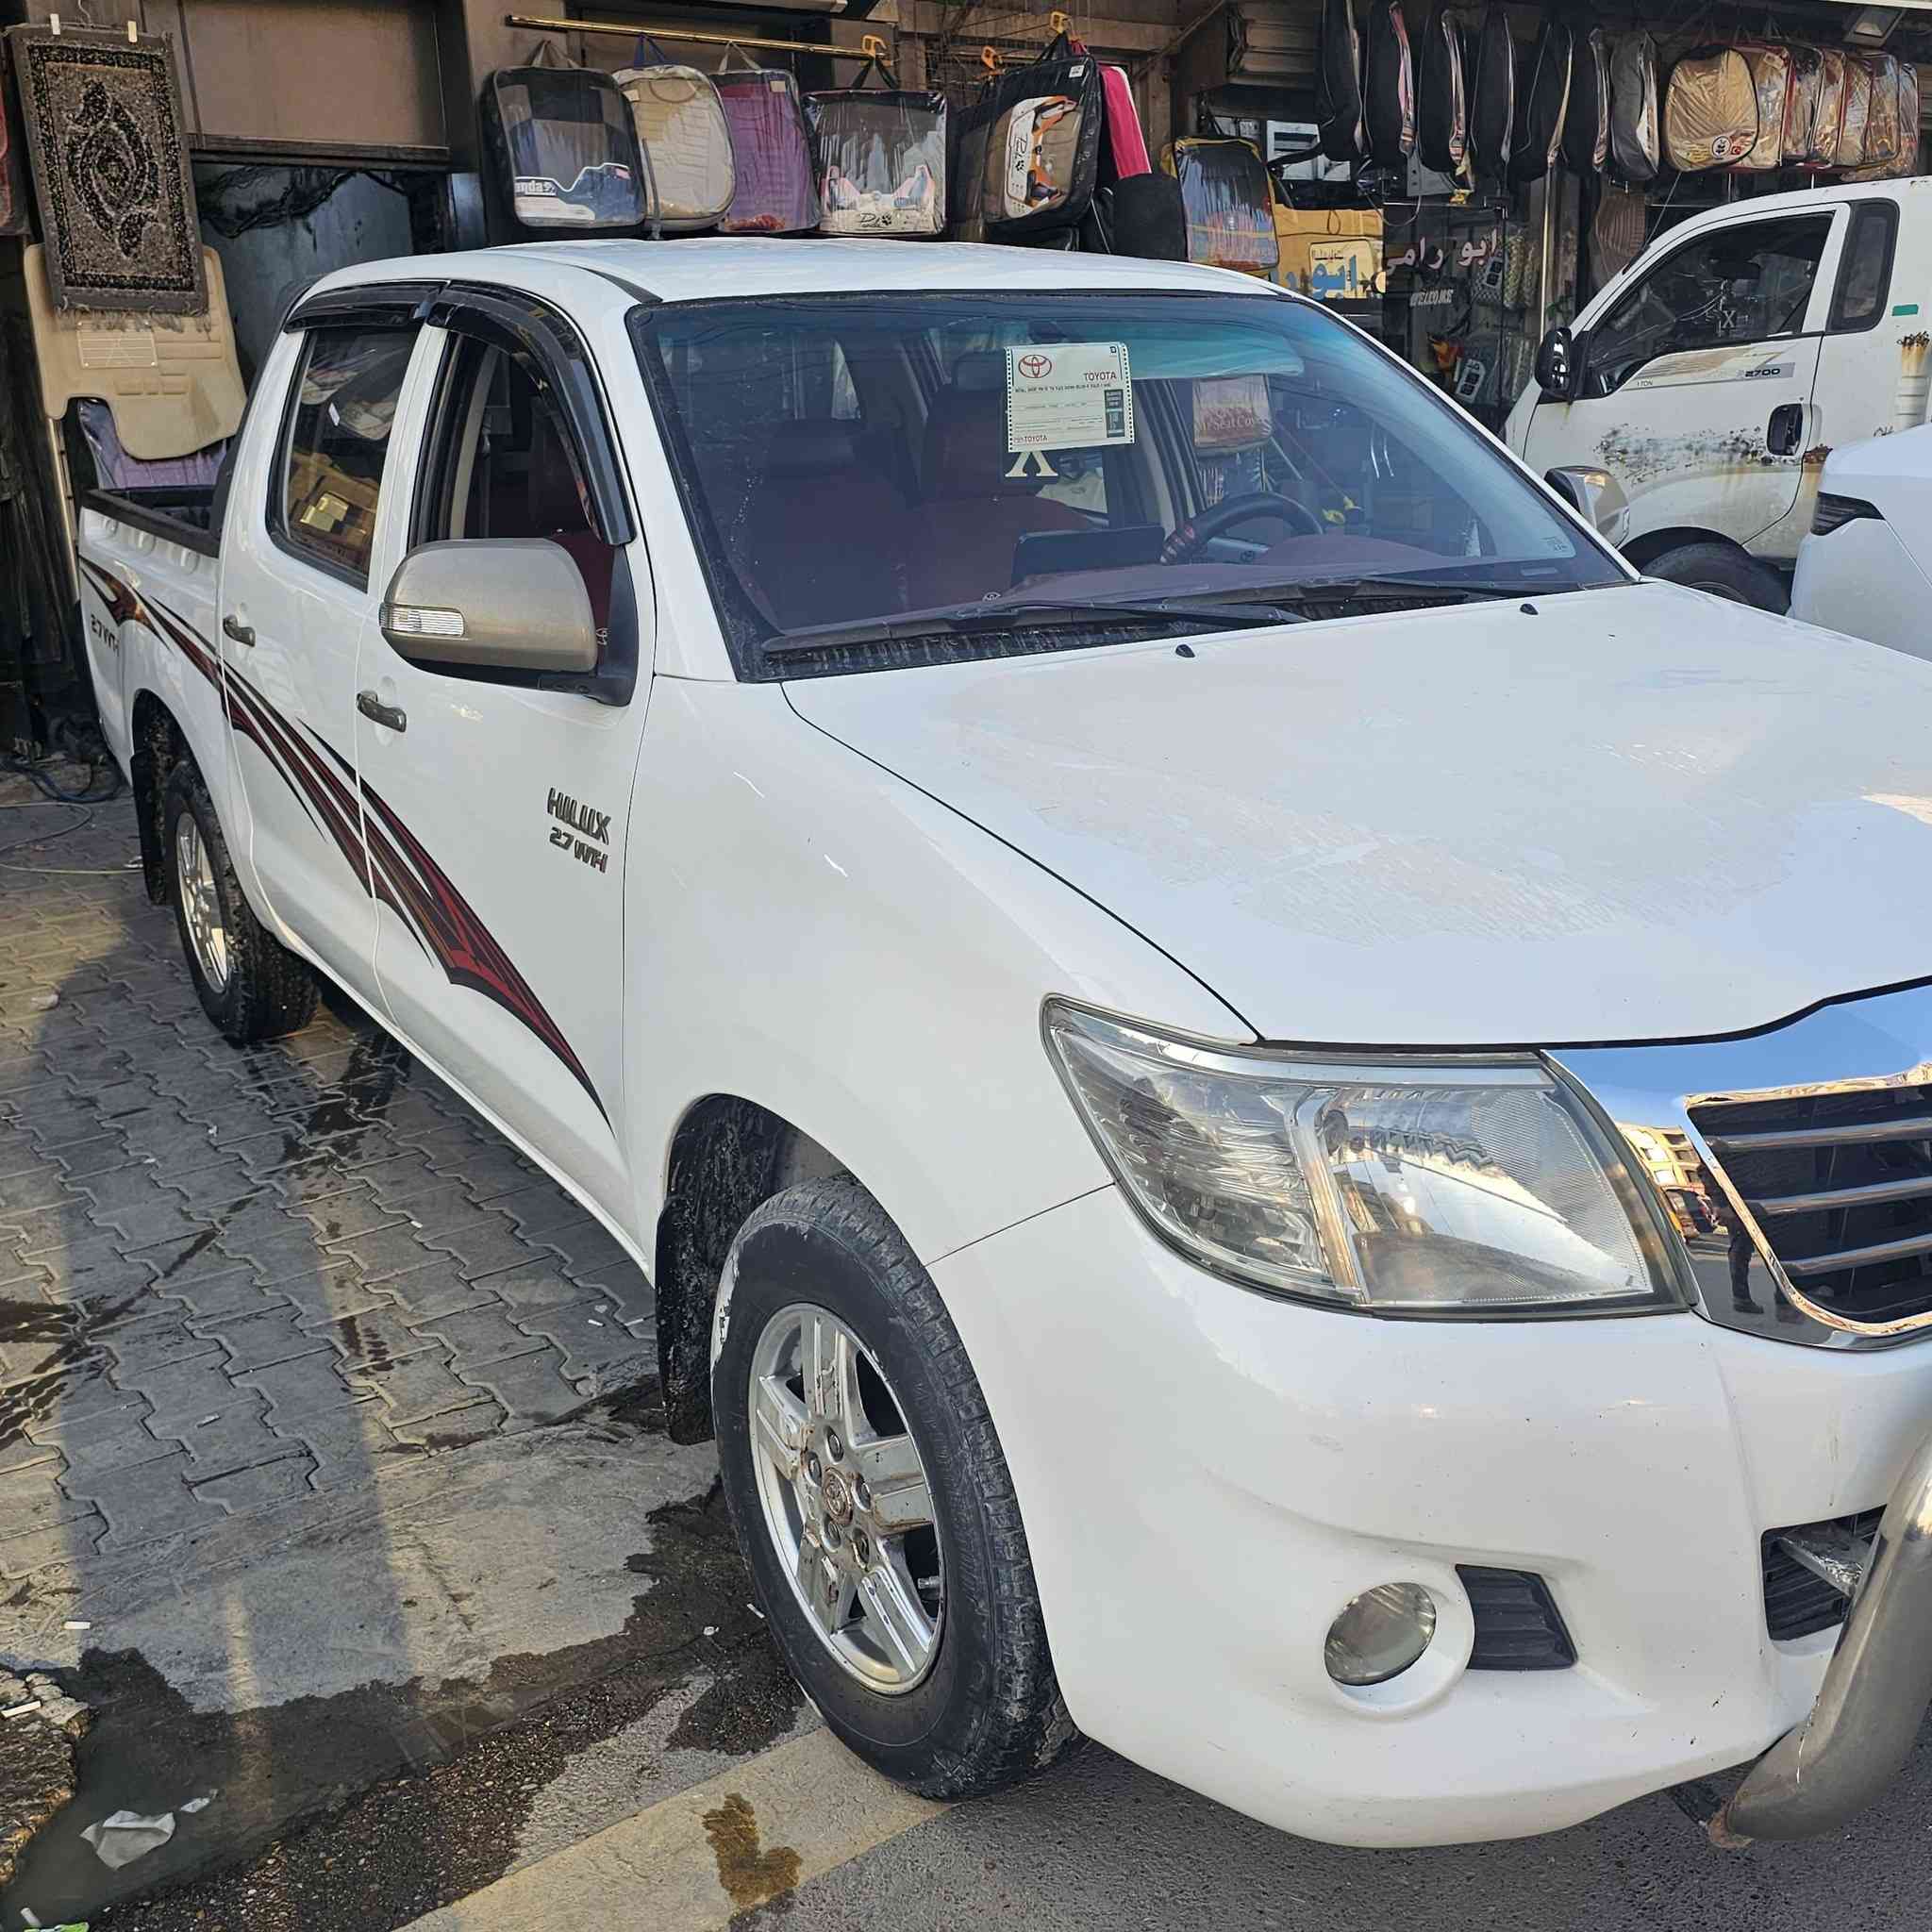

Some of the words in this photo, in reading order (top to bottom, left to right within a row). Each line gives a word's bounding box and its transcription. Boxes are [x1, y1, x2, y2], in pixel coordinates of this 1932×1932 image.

[1084, 371, 1117, 381] TOYOTA
[1024, 435, 1048, 443] TOYOTA
[547, 787, 611, 845] HILUX
